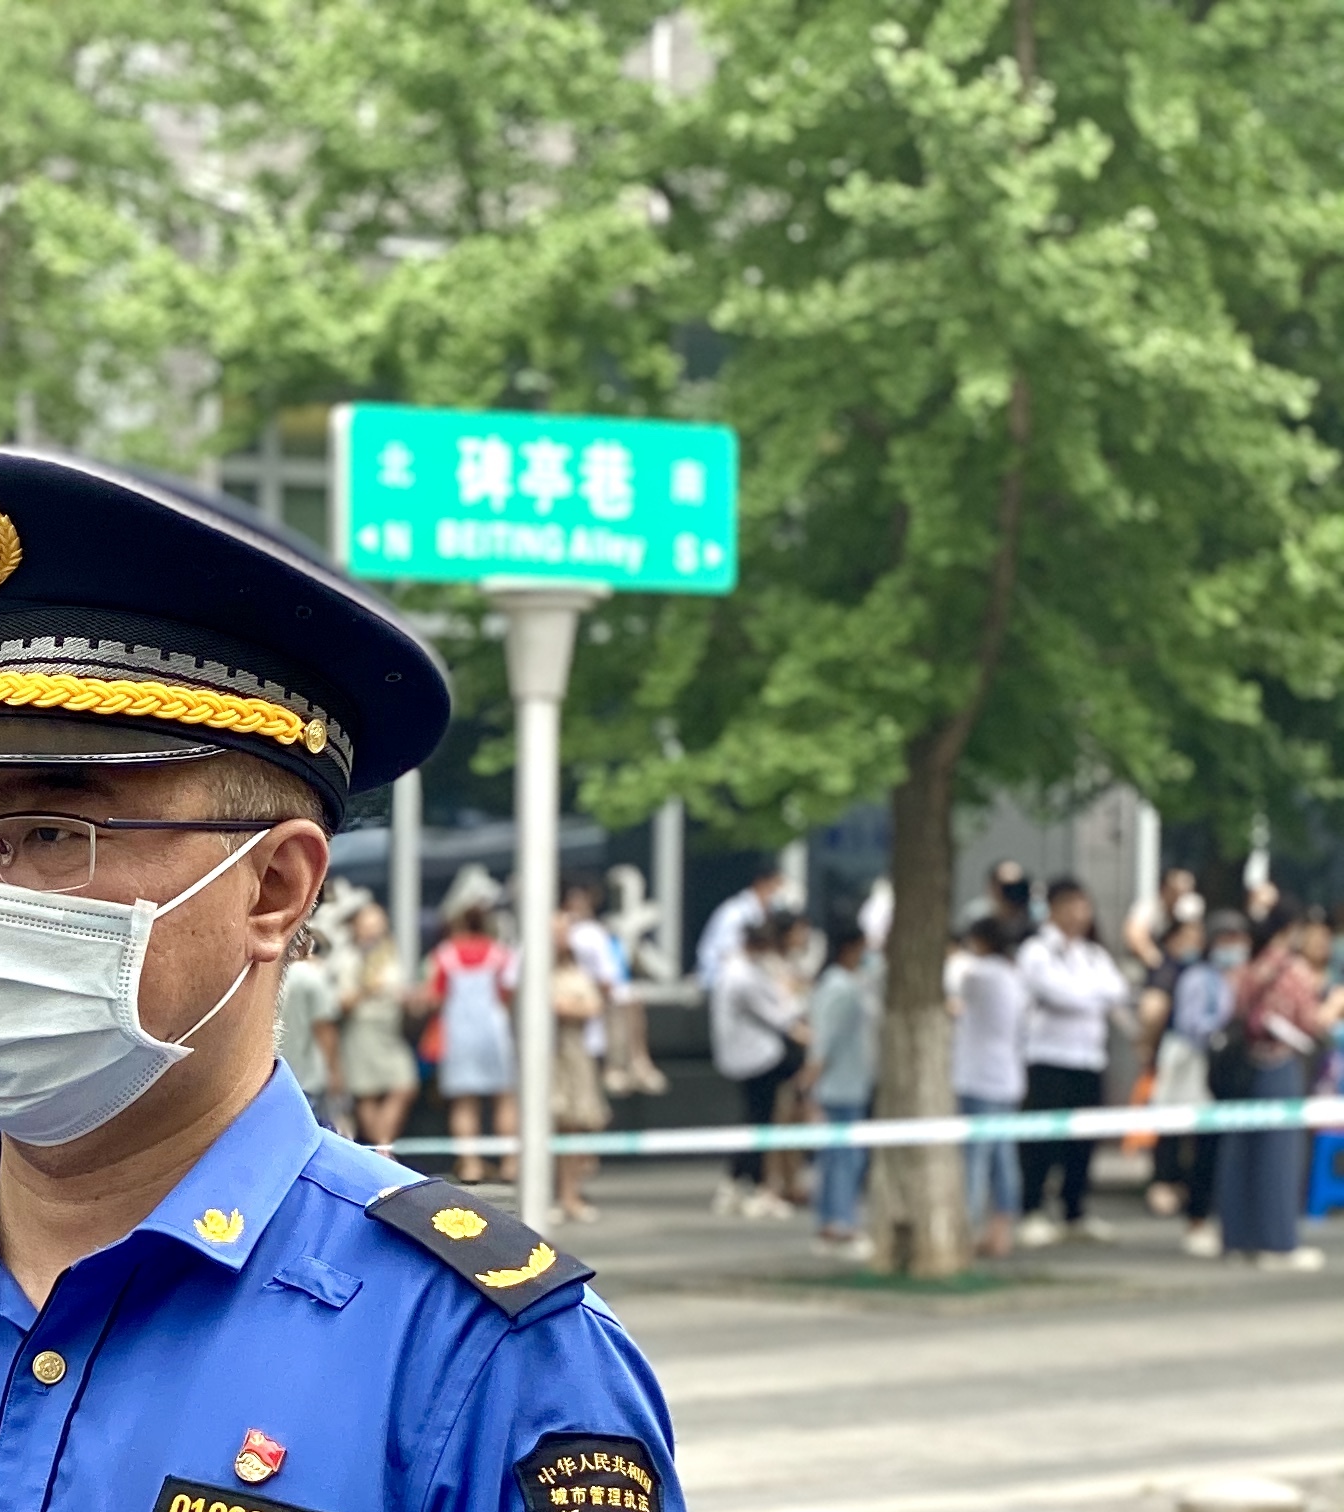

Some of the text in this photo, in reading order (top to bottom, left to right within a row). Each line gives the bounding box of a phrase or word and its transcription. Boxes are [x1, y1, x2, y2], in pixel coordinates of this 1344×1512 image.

[455, 433, 635, 521] 碑亭巷
[537, 1452, 653, 1495] 中华人民共和国
